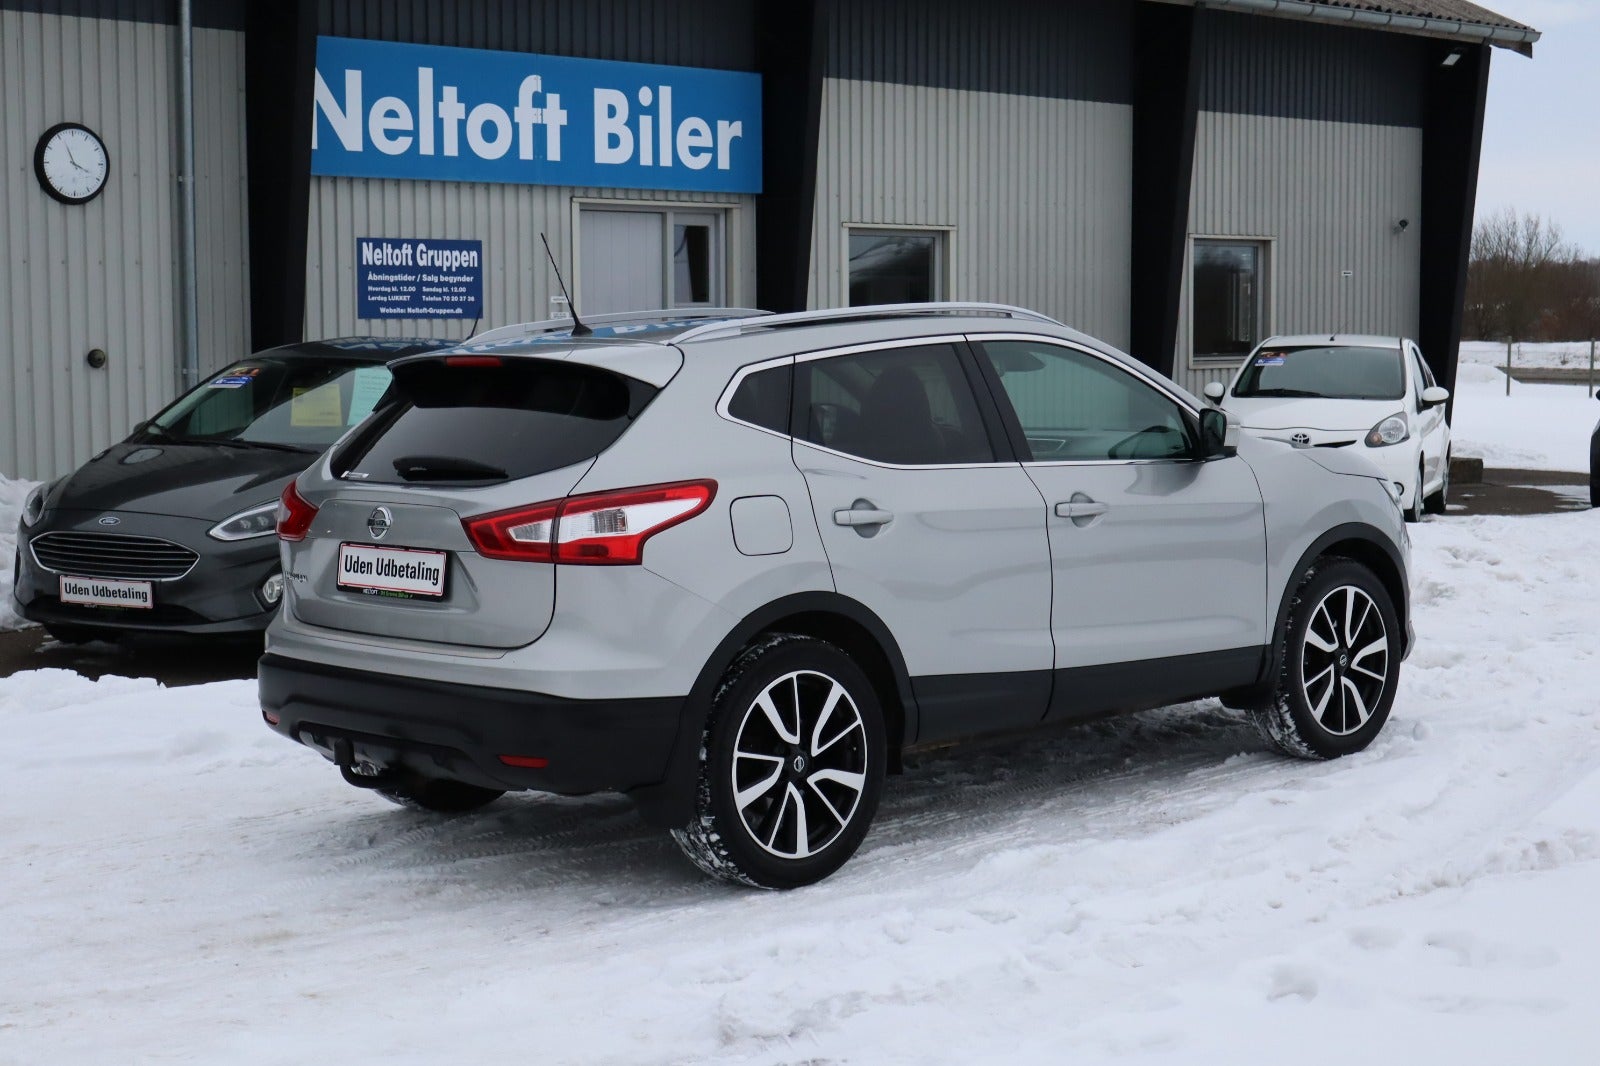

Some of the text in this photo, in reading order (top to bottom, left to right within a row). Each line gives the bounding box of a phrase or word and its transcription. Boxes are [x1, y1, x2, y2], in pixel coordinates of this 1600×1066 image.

[311, 66, 742, 170] Neltoft Biler
[362, 242, 478, 272] Neltoft Gruppen
[367, 271, 474, 283] Åbningstider / Salg begynder
[344, 554, 440, 586] Uden Udbetaling
[64, 583, 148, 603] Uden Udbetaling
